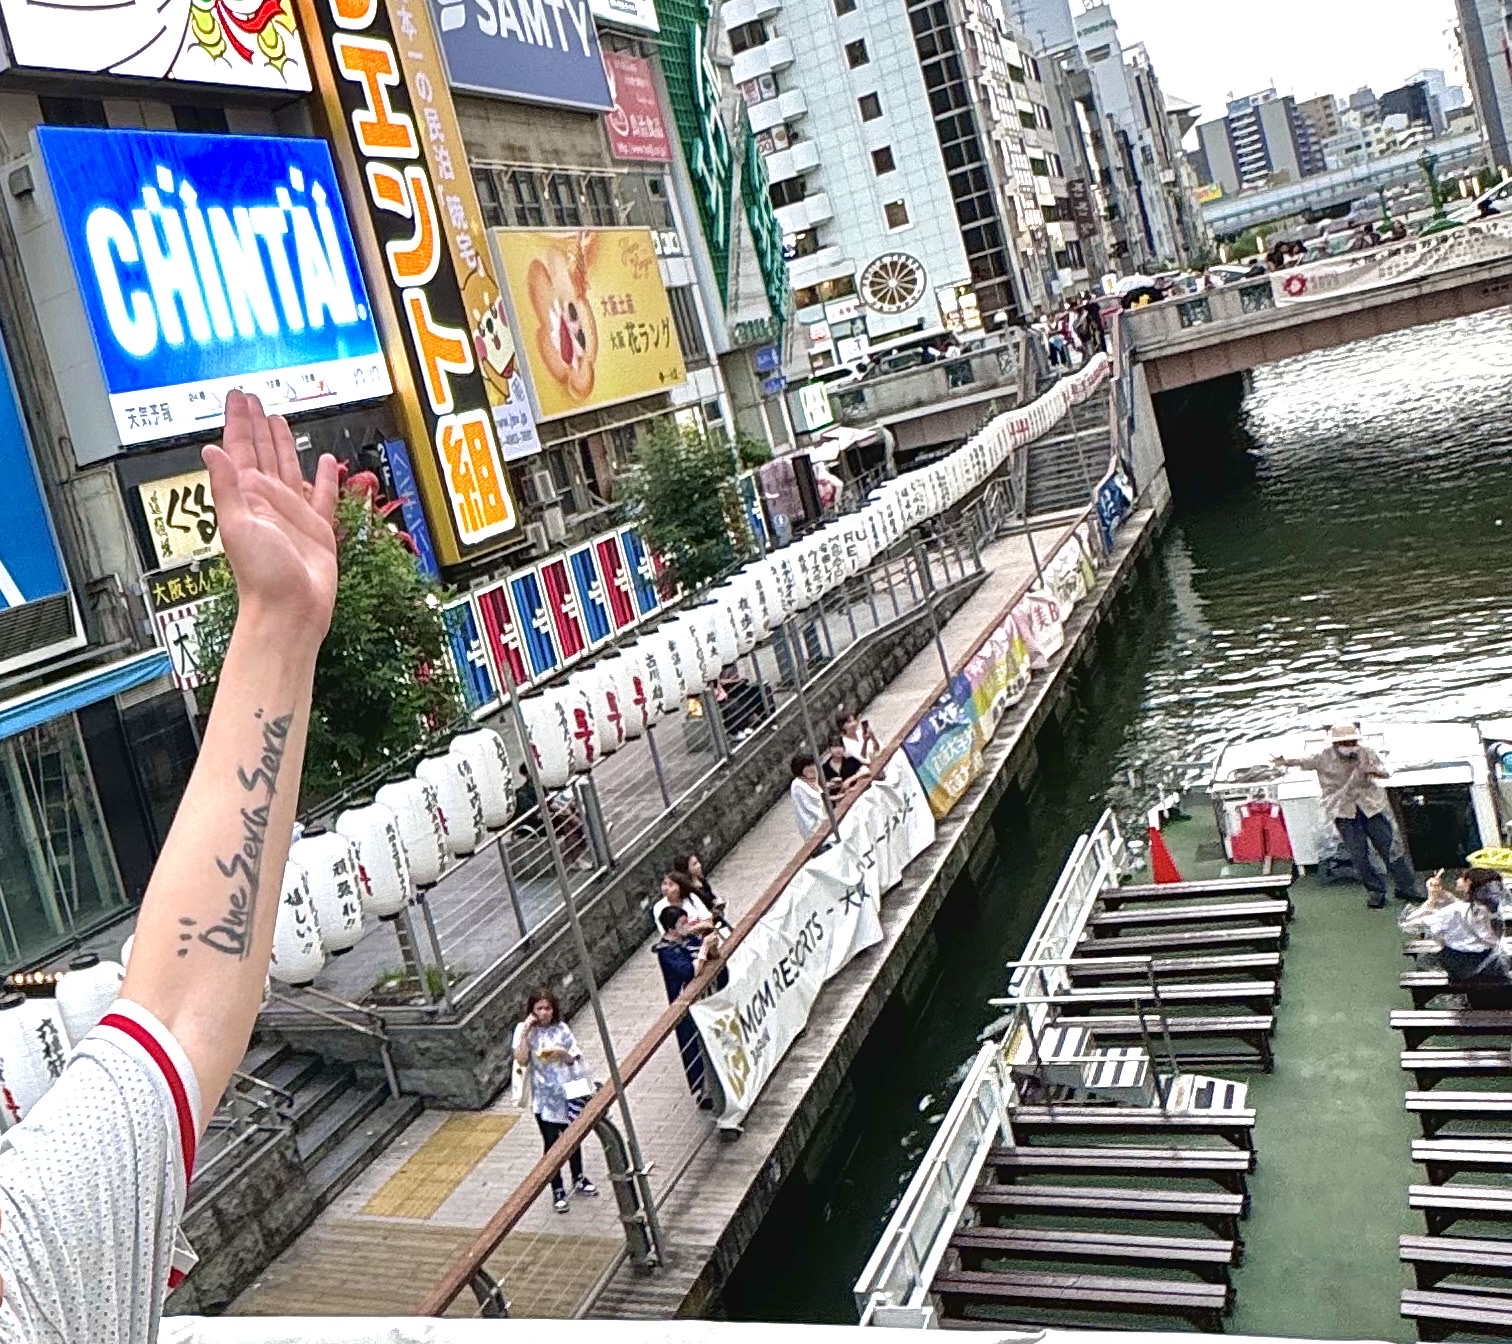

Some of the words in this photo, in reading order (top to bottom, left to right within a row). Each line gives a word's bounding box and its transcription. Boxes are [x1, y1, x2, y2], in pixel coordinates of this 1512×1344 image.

[166, 483, 219, 545] くくる
[740, 977, 777, 1045] MGM
[771, 913, 827, 997] RESORTS
